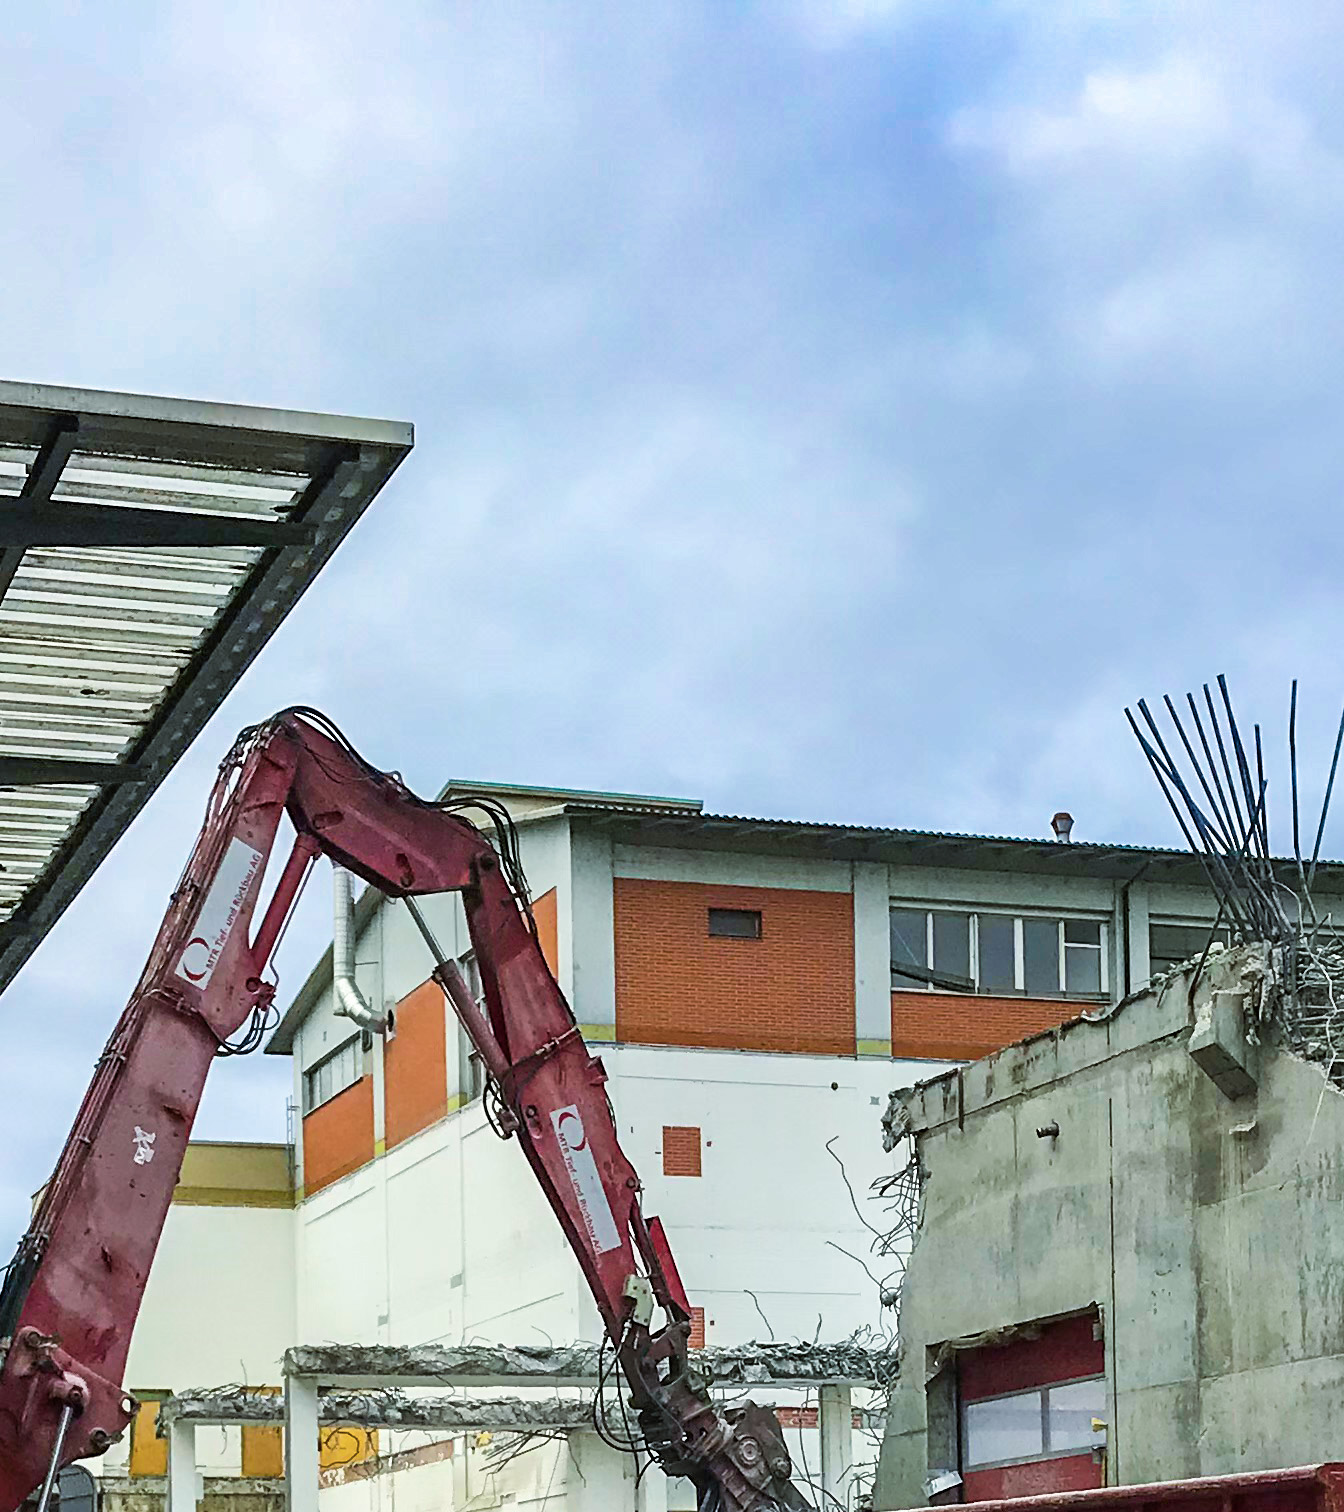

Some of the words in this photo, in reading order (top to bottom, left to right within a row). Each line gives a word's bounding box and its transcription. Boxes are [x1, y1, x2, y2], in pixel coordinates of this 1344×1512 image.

[205, 948, 219, 969] MTR
[226, 907, 238, 926] und
[233, 869, 254, 906] Rückbau
[249, 854, 261, 868] AG
[573, 1178, 584, 1196] und
